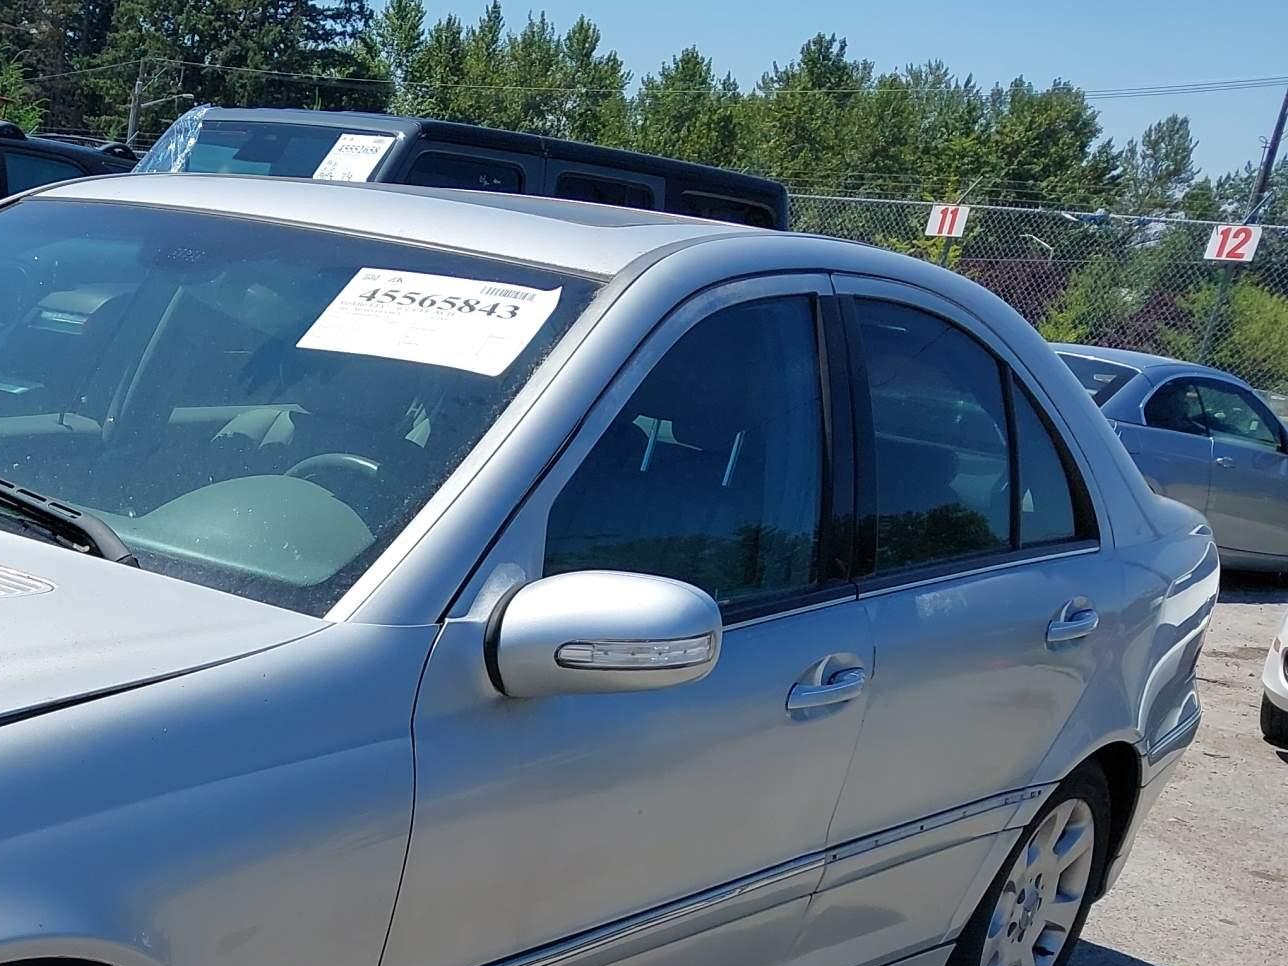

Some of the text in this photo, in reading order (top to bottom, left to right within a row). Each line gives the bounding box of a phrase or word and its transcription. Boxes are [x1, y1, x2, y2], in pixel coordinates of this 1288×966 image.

[937, 207, 960, 235] 11
[1215, 227, 1253, 259] 12
[359, 287, 522, 320] 45565843
